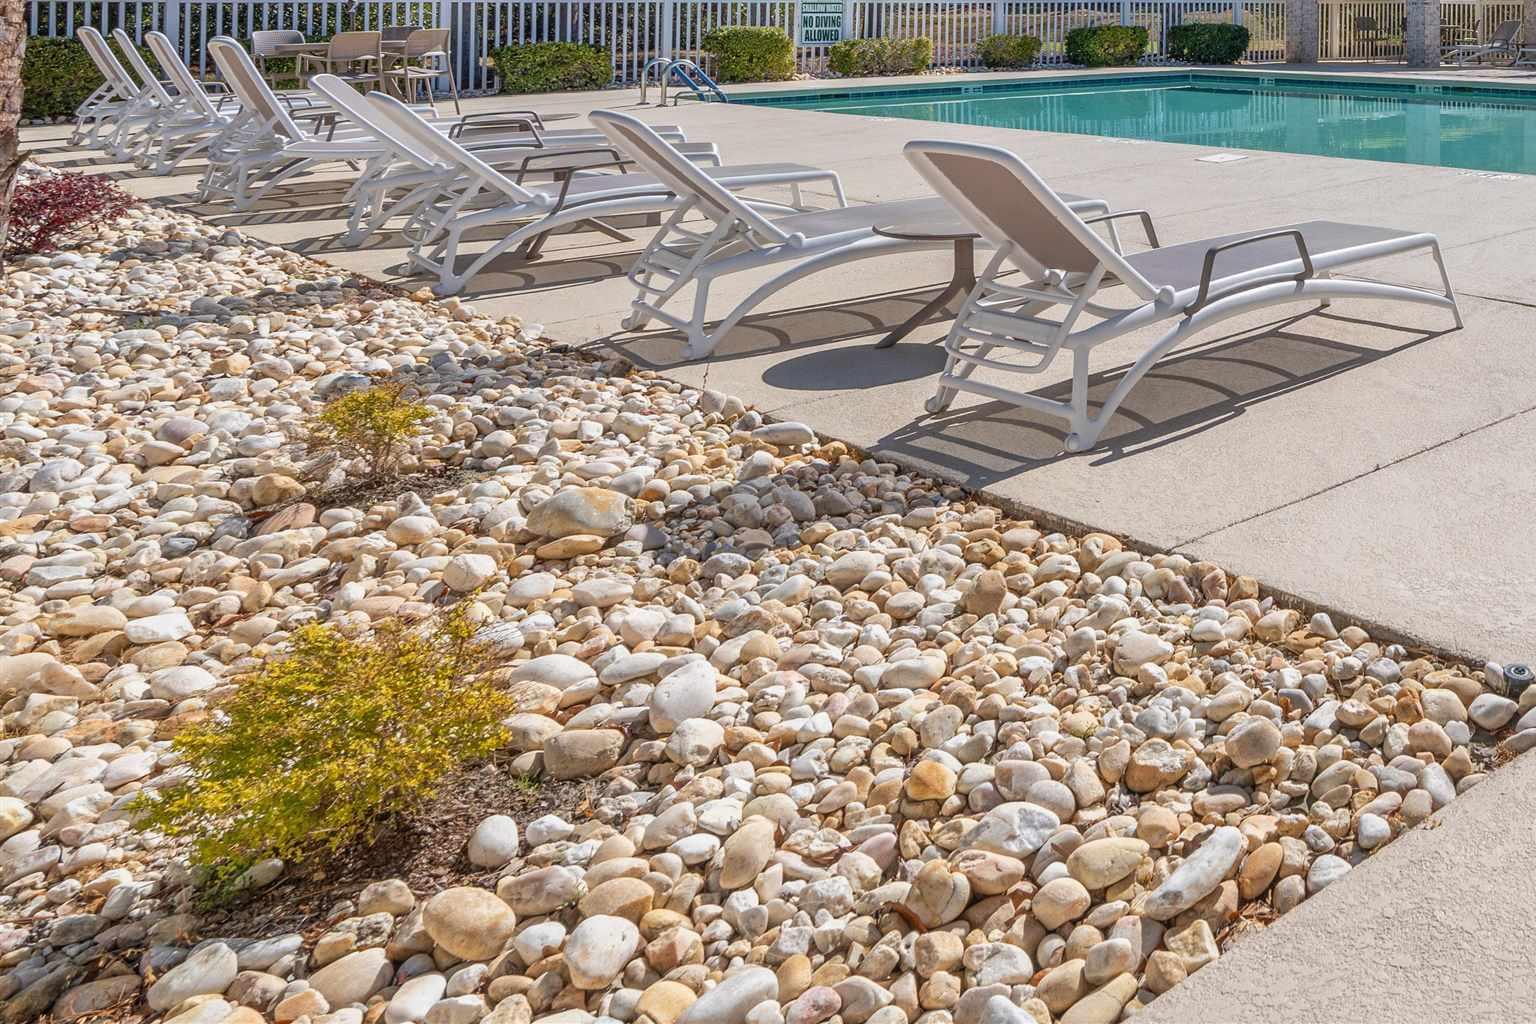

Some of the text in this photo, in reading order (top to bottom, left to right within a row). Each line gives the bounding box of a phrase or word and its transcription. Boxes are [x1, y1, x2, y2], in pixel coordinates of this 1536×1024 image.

[803, 16, 842, 28] NO DIVING
[804, 30, 839, 42] ALLOWED
